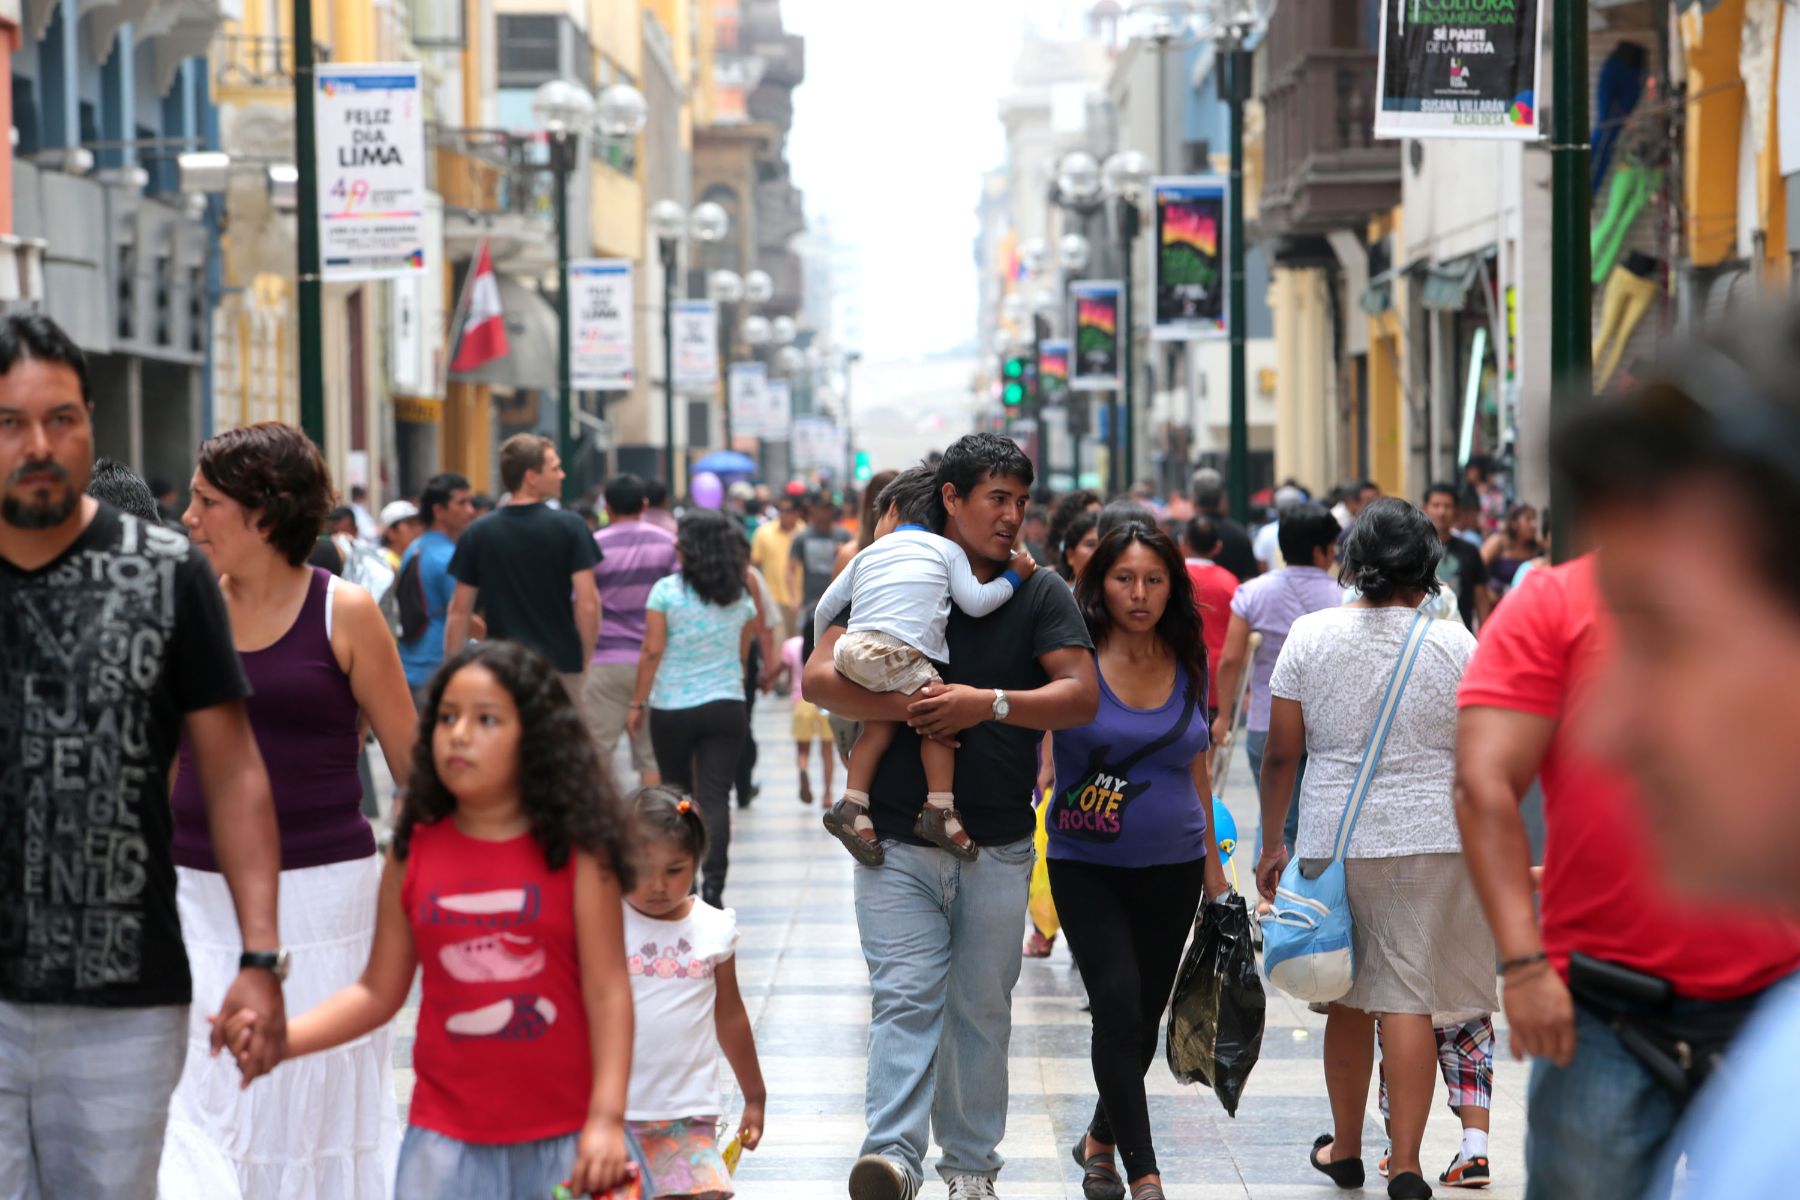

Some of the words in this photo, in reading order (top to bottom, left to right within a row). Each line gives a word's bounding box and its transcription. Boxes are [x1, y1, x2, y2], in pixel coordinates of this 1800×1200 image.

[1426, 0, 1515, 11] CULTURA
[1449, 28, 1487, 41] PARTE
[1426, 41, 1440, 53] DE
[1441, 42, 1454, 53] LA
[1456, 41, 1495, 53] FIESTA
[1421, 99, 1458, 112] SUSANA
[345, 109, 391, 124] FELIZ
[338, 146, 403, 167] LIMA
[1094, 772, 1129, 792] MY
[1058, 808, 1121, 833] ROCKS
